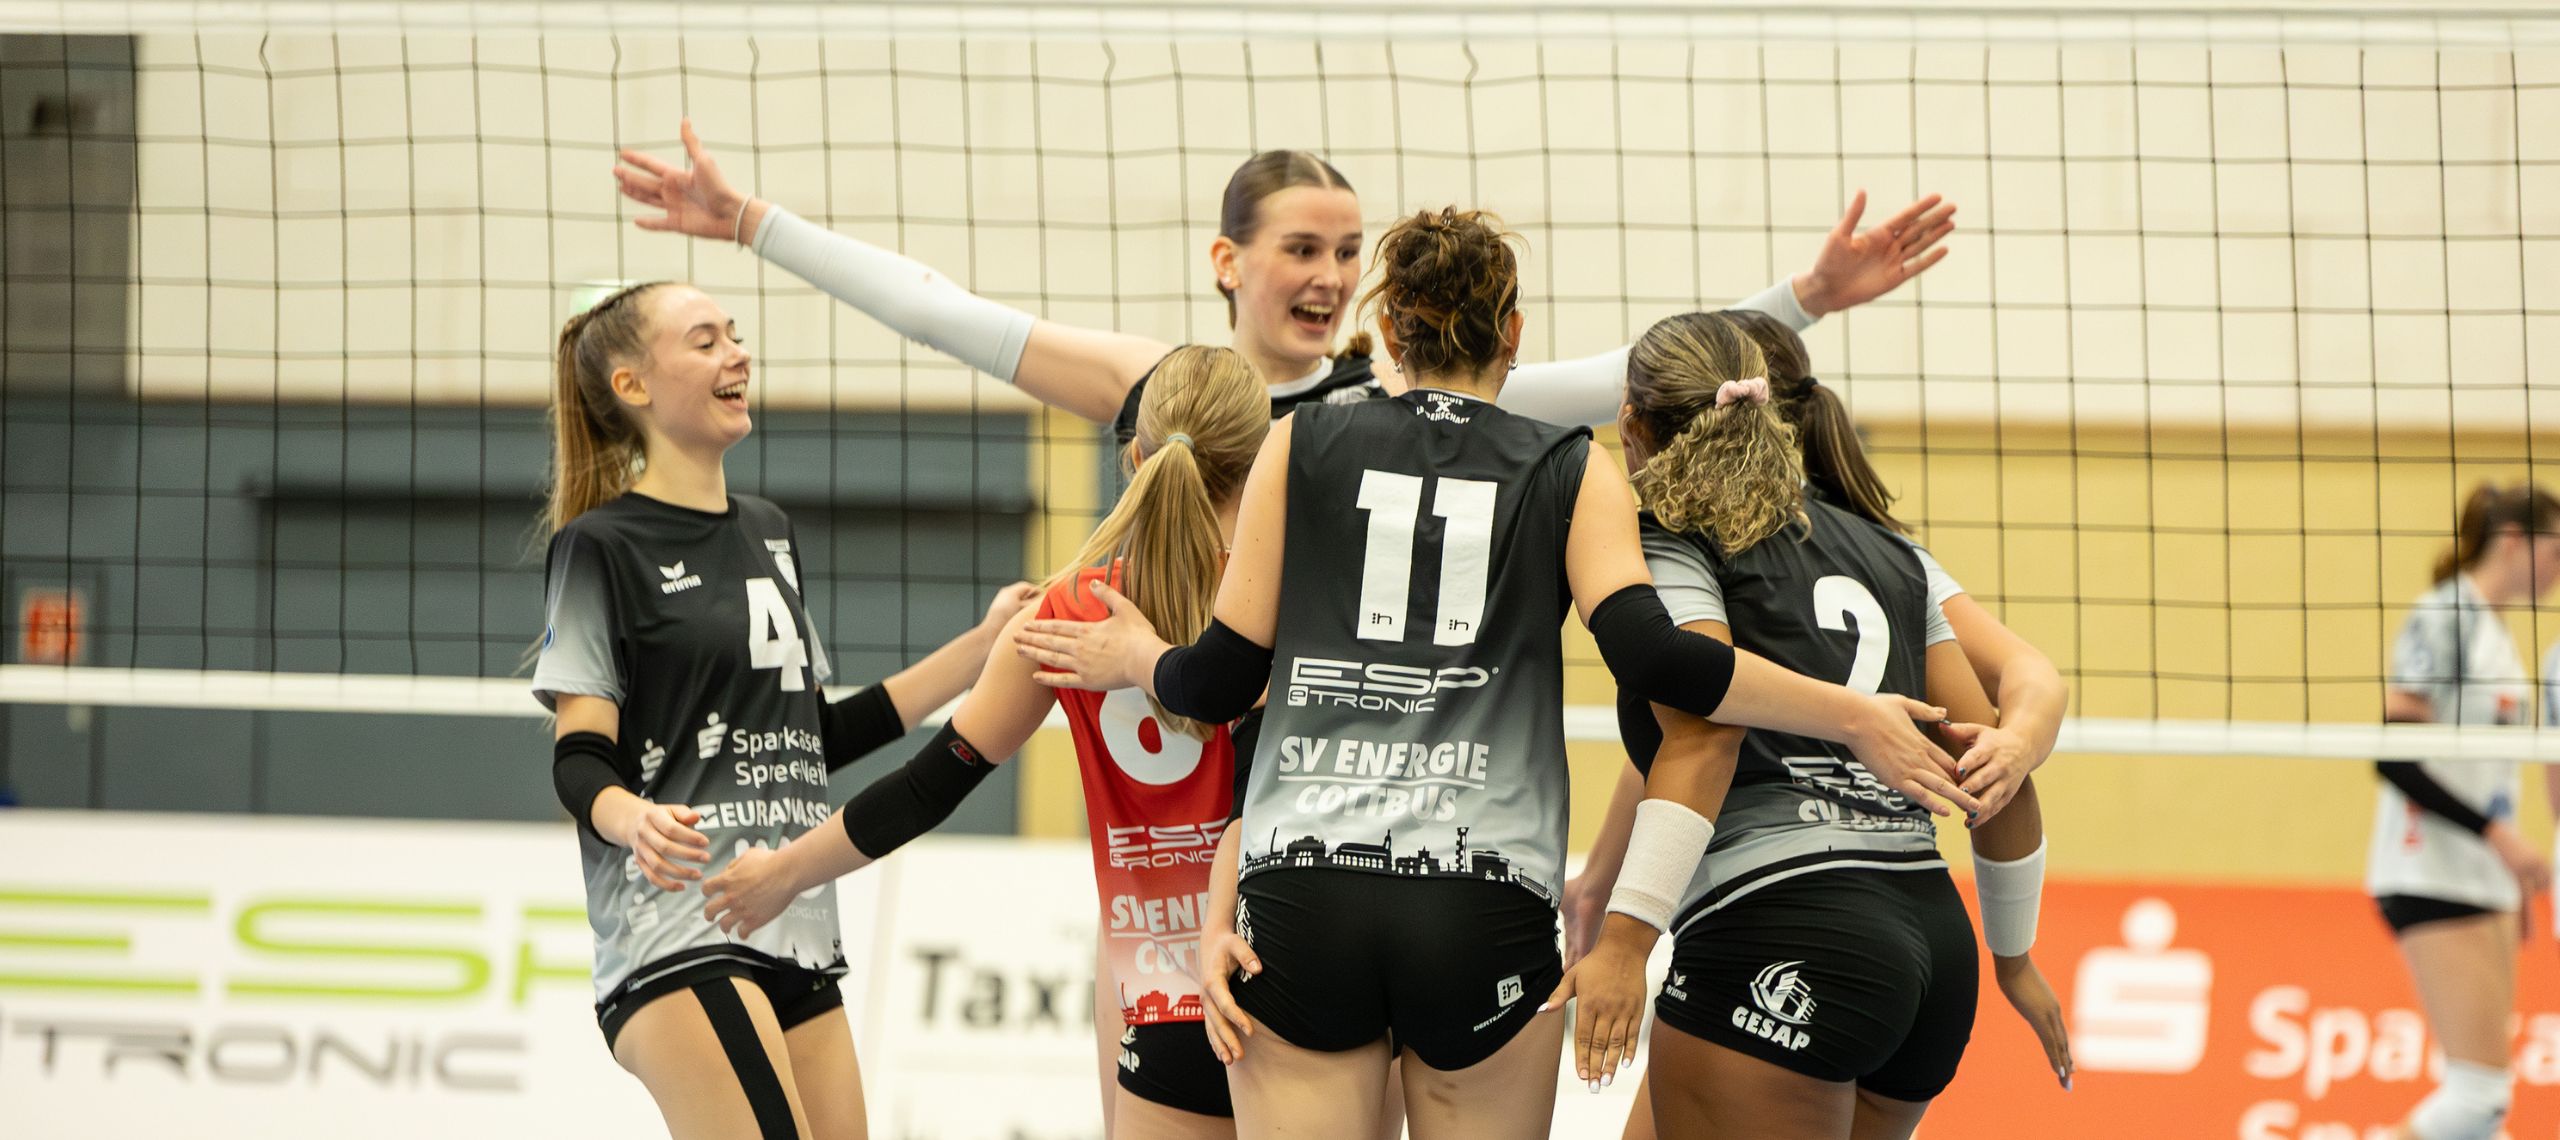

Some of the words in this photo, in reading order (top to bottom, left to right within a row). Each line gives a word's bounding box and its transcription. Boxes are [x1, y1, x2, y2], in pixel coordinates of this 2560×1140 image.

[1356, 469, 1498, 646] 11
[746, 577, 808, 691] 4
[1279, 736, 1328, 773] SV
[1334, 740, 1490, 781] ENERGIE
[1295, 784, 1457, 822] COTTBUS
[1732, 1006, 1811, 1050] GESAP
[2243, 984, 2560, 1100] Spaa
